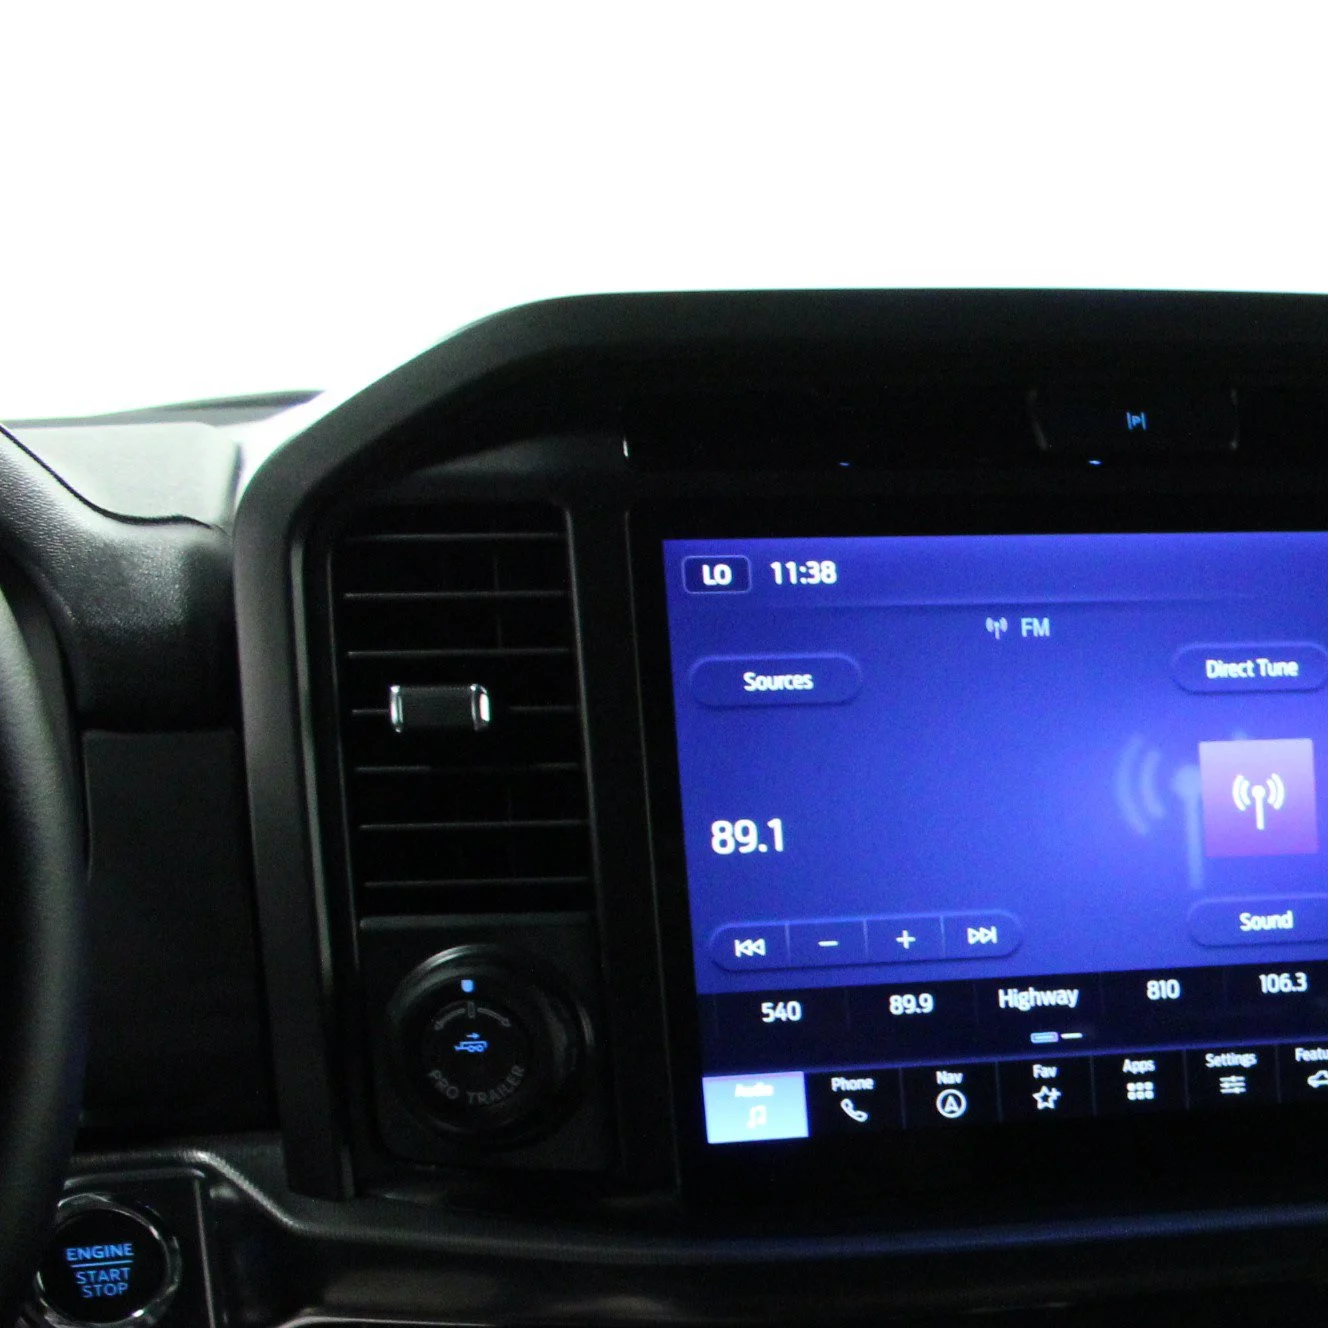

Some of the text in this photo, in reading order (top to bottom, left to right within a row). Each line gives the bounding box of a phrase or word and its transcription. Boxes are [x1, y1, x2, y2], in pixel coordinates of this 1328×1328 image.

[702, 564, 732, 587] LO
[770, 559, 838, 586] 11:38
[1021, 617, 1051, 638] FM
[1205, 656, 1299, 680] Direct Tune
[742, 671, 815, 693] Sources
[711, 818, 784, 855] 89.1
[1239, 909, 1294, 932] Sound
[1146, 979, 1180, 1000] 810
[1258, 972, 1308, 994] 106.3
[889, 993, 934, 1016] 89.9
[998, 987, 1079, 1010] Highway
[761, 1000, 802, 1023] 540
[1033, 1064, 1058, 1079] Fav
[1122, 1059, 1156, 1074] Apps
[1205, 1053, 1257, 1069] Settings
[831, 1077, 874, 1092] Phone
[936, 1070, 963, 1085] Nav
[65, 1242, 135, 1261] ENGINE
[74, 1266, 132, 1285] START
[81, 1282, 129, 1299] STOP
